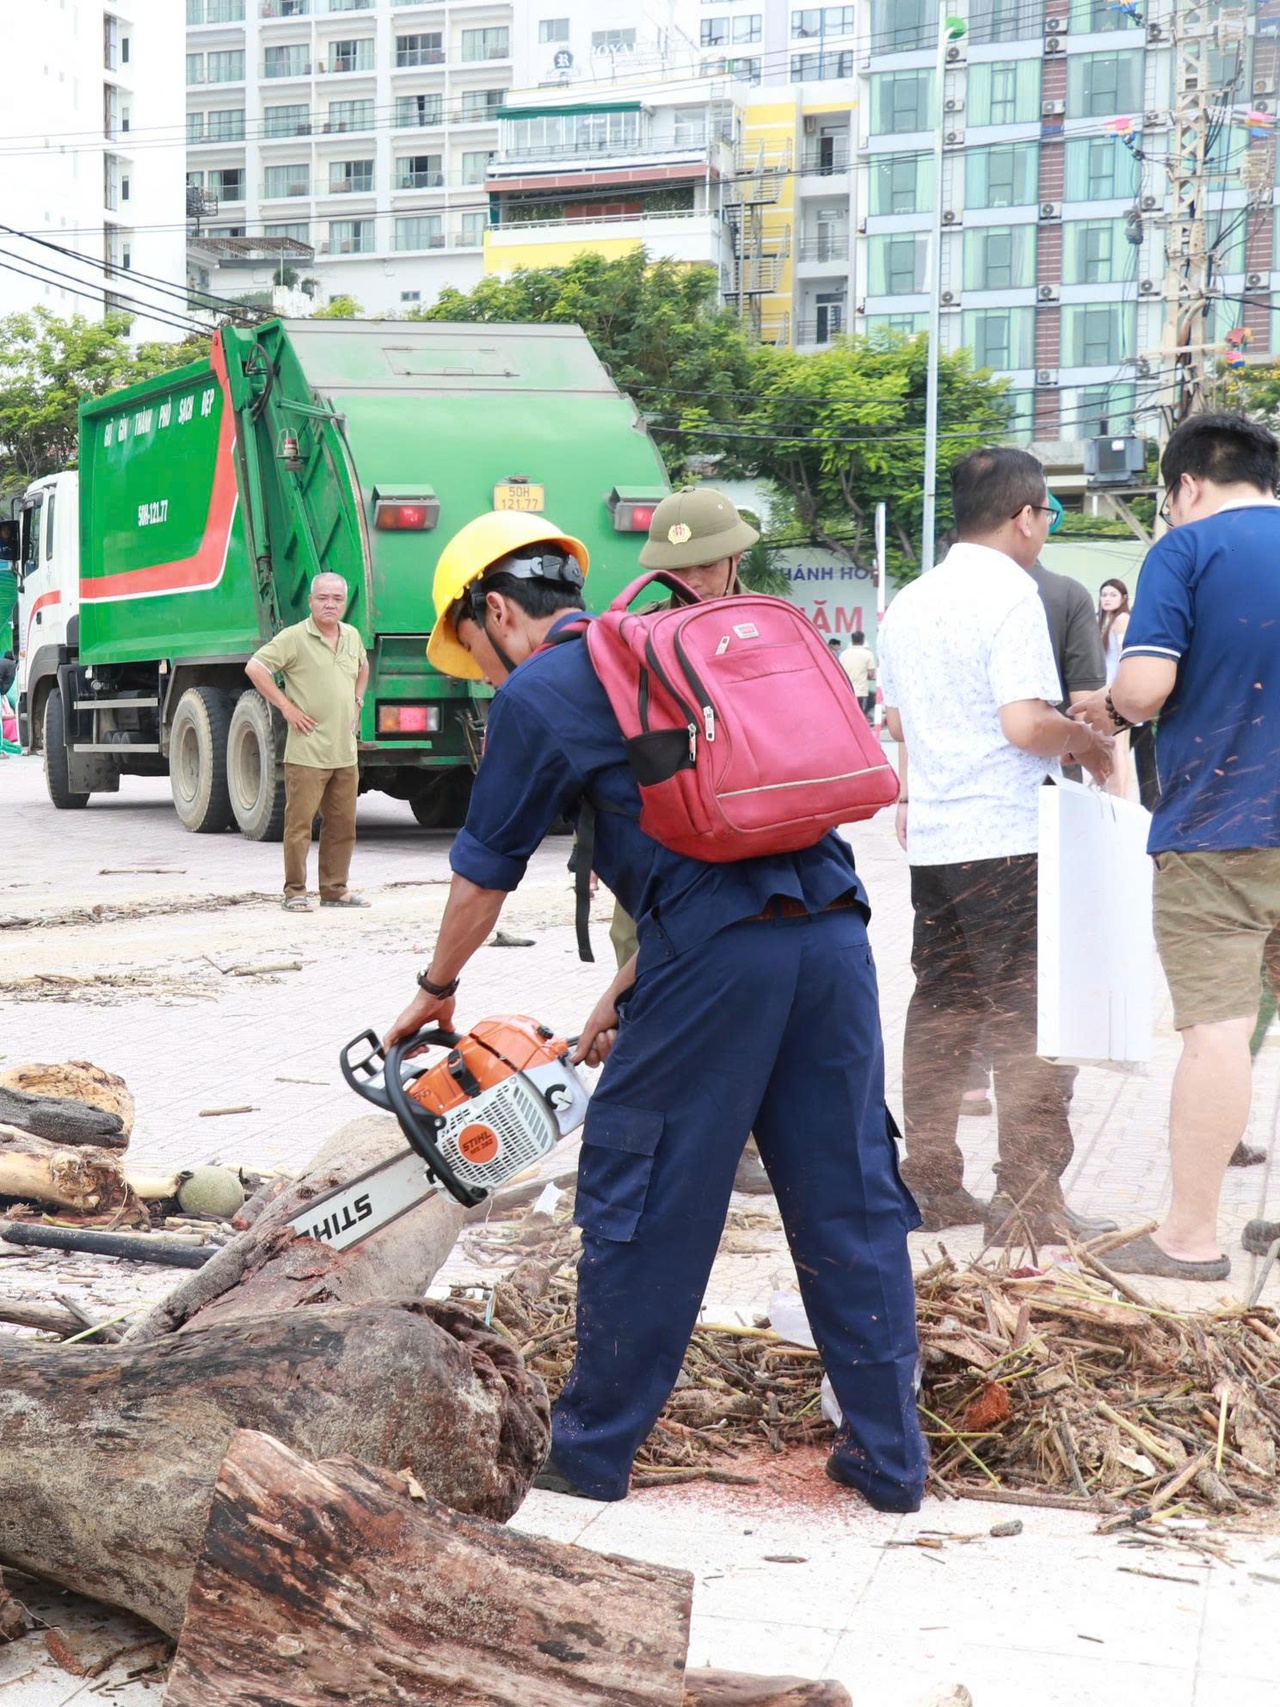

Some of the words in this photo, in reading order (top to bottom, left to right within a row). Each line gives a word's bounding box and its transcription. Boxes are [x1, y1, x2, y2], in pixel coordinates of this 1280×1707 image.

[178, 394, 195, 425] SẠCH
[200, 388, 215, 418] ĐẸP
[508, 485, 531, 498] 50H
[501, 498, 539, 510] 121.77
[782, 564, 833, 580] HÁNH
[800, 600, 863, 633] ĂM
[462, 1131, 492, 1152] STIHL
[296, 1193, 373, 1242] STIH
